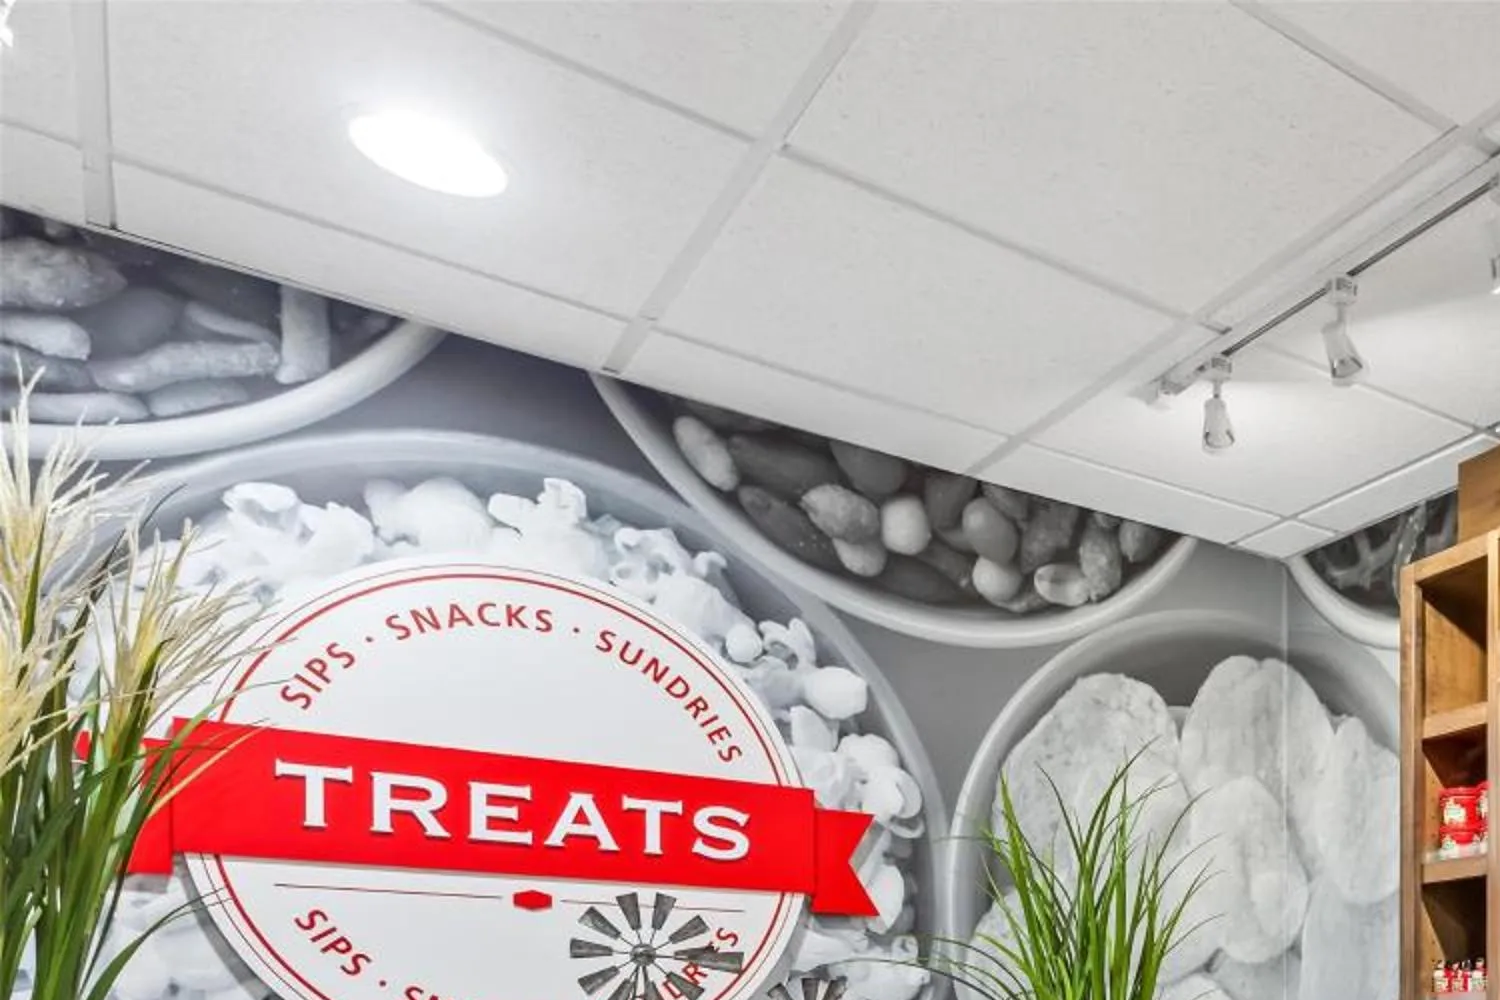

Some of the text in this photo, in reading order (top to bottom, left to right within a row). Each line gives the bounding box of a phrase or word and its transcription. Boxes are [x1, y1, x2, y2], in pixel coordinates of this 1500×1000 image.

[279, 601, 743, 765] SIPS SNACKS SUNDRIES
[273, 757, 752, 863] TREATS
[294, 907, 372, 977] SIPS
